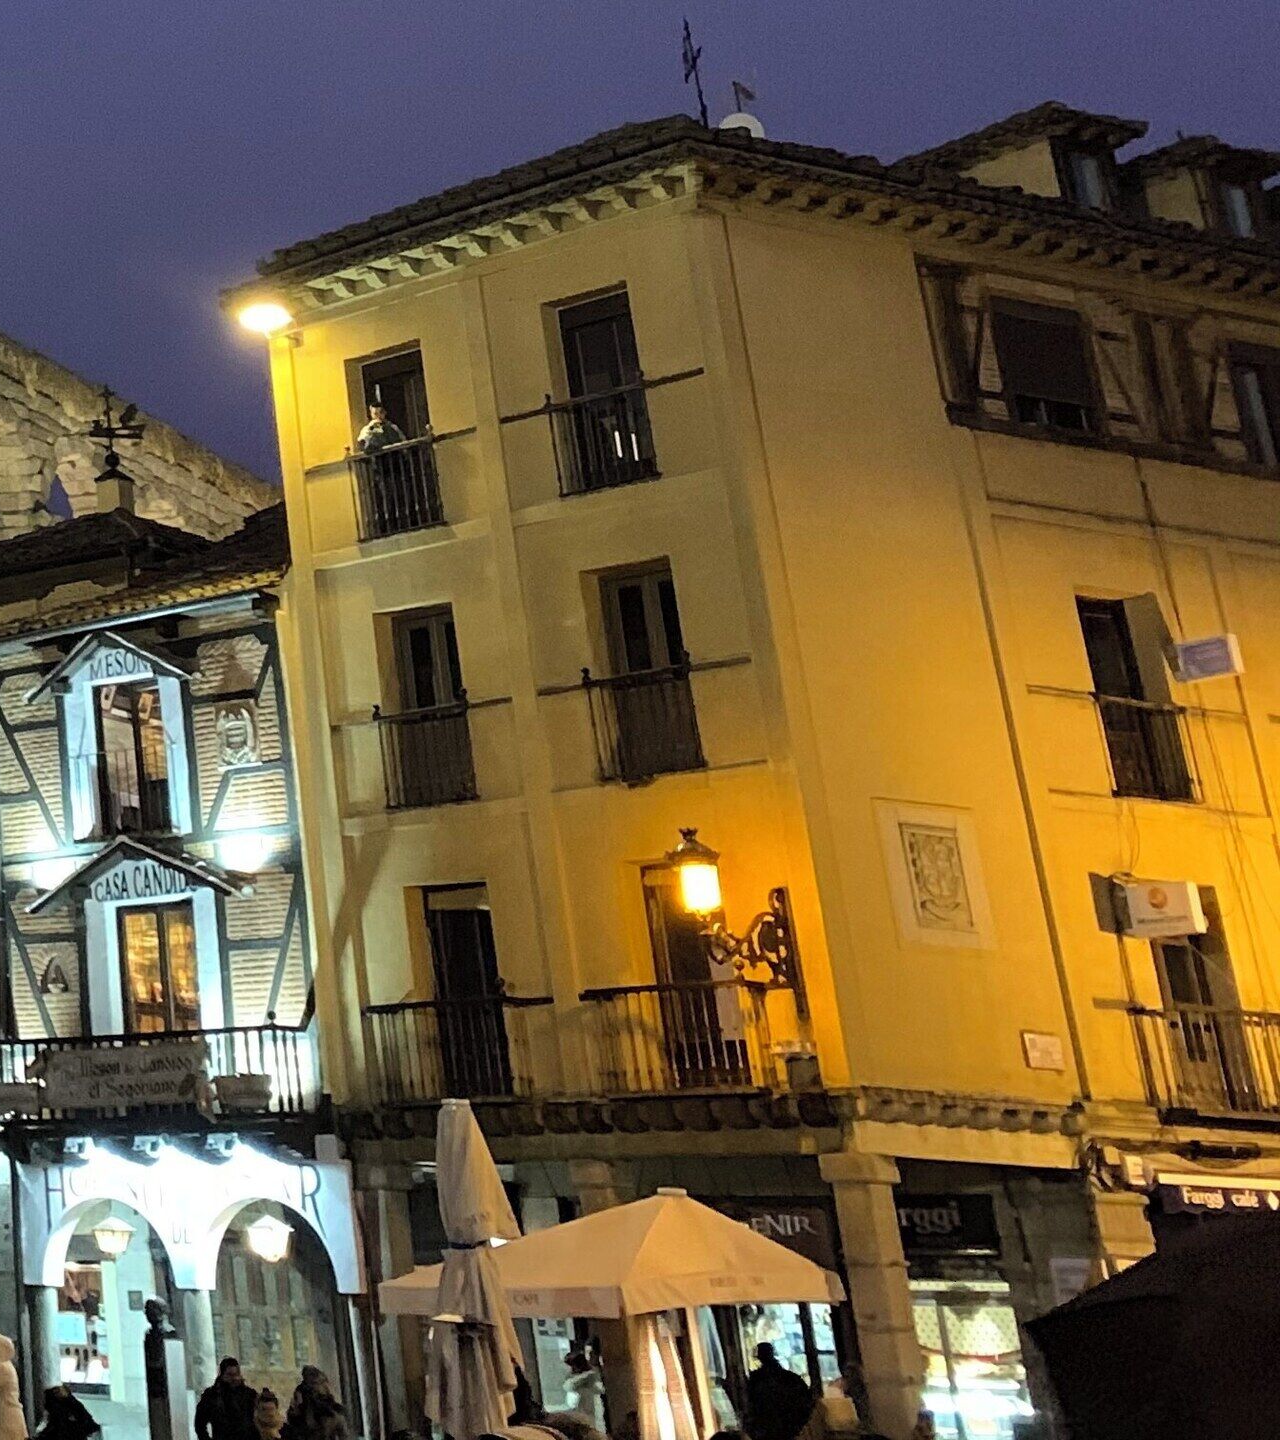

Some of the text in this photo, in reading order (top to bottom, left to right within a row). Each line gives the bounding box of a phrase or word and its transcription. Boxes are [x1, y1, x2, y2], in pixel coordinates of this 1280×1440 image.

[95, 864, 197, 902] CASA CANDID
[1181, 1186, 1225, 1210] Farggi
[751, 1213, 820, 1237] ENIR
[899, 1201, 962, 1234] rggi
